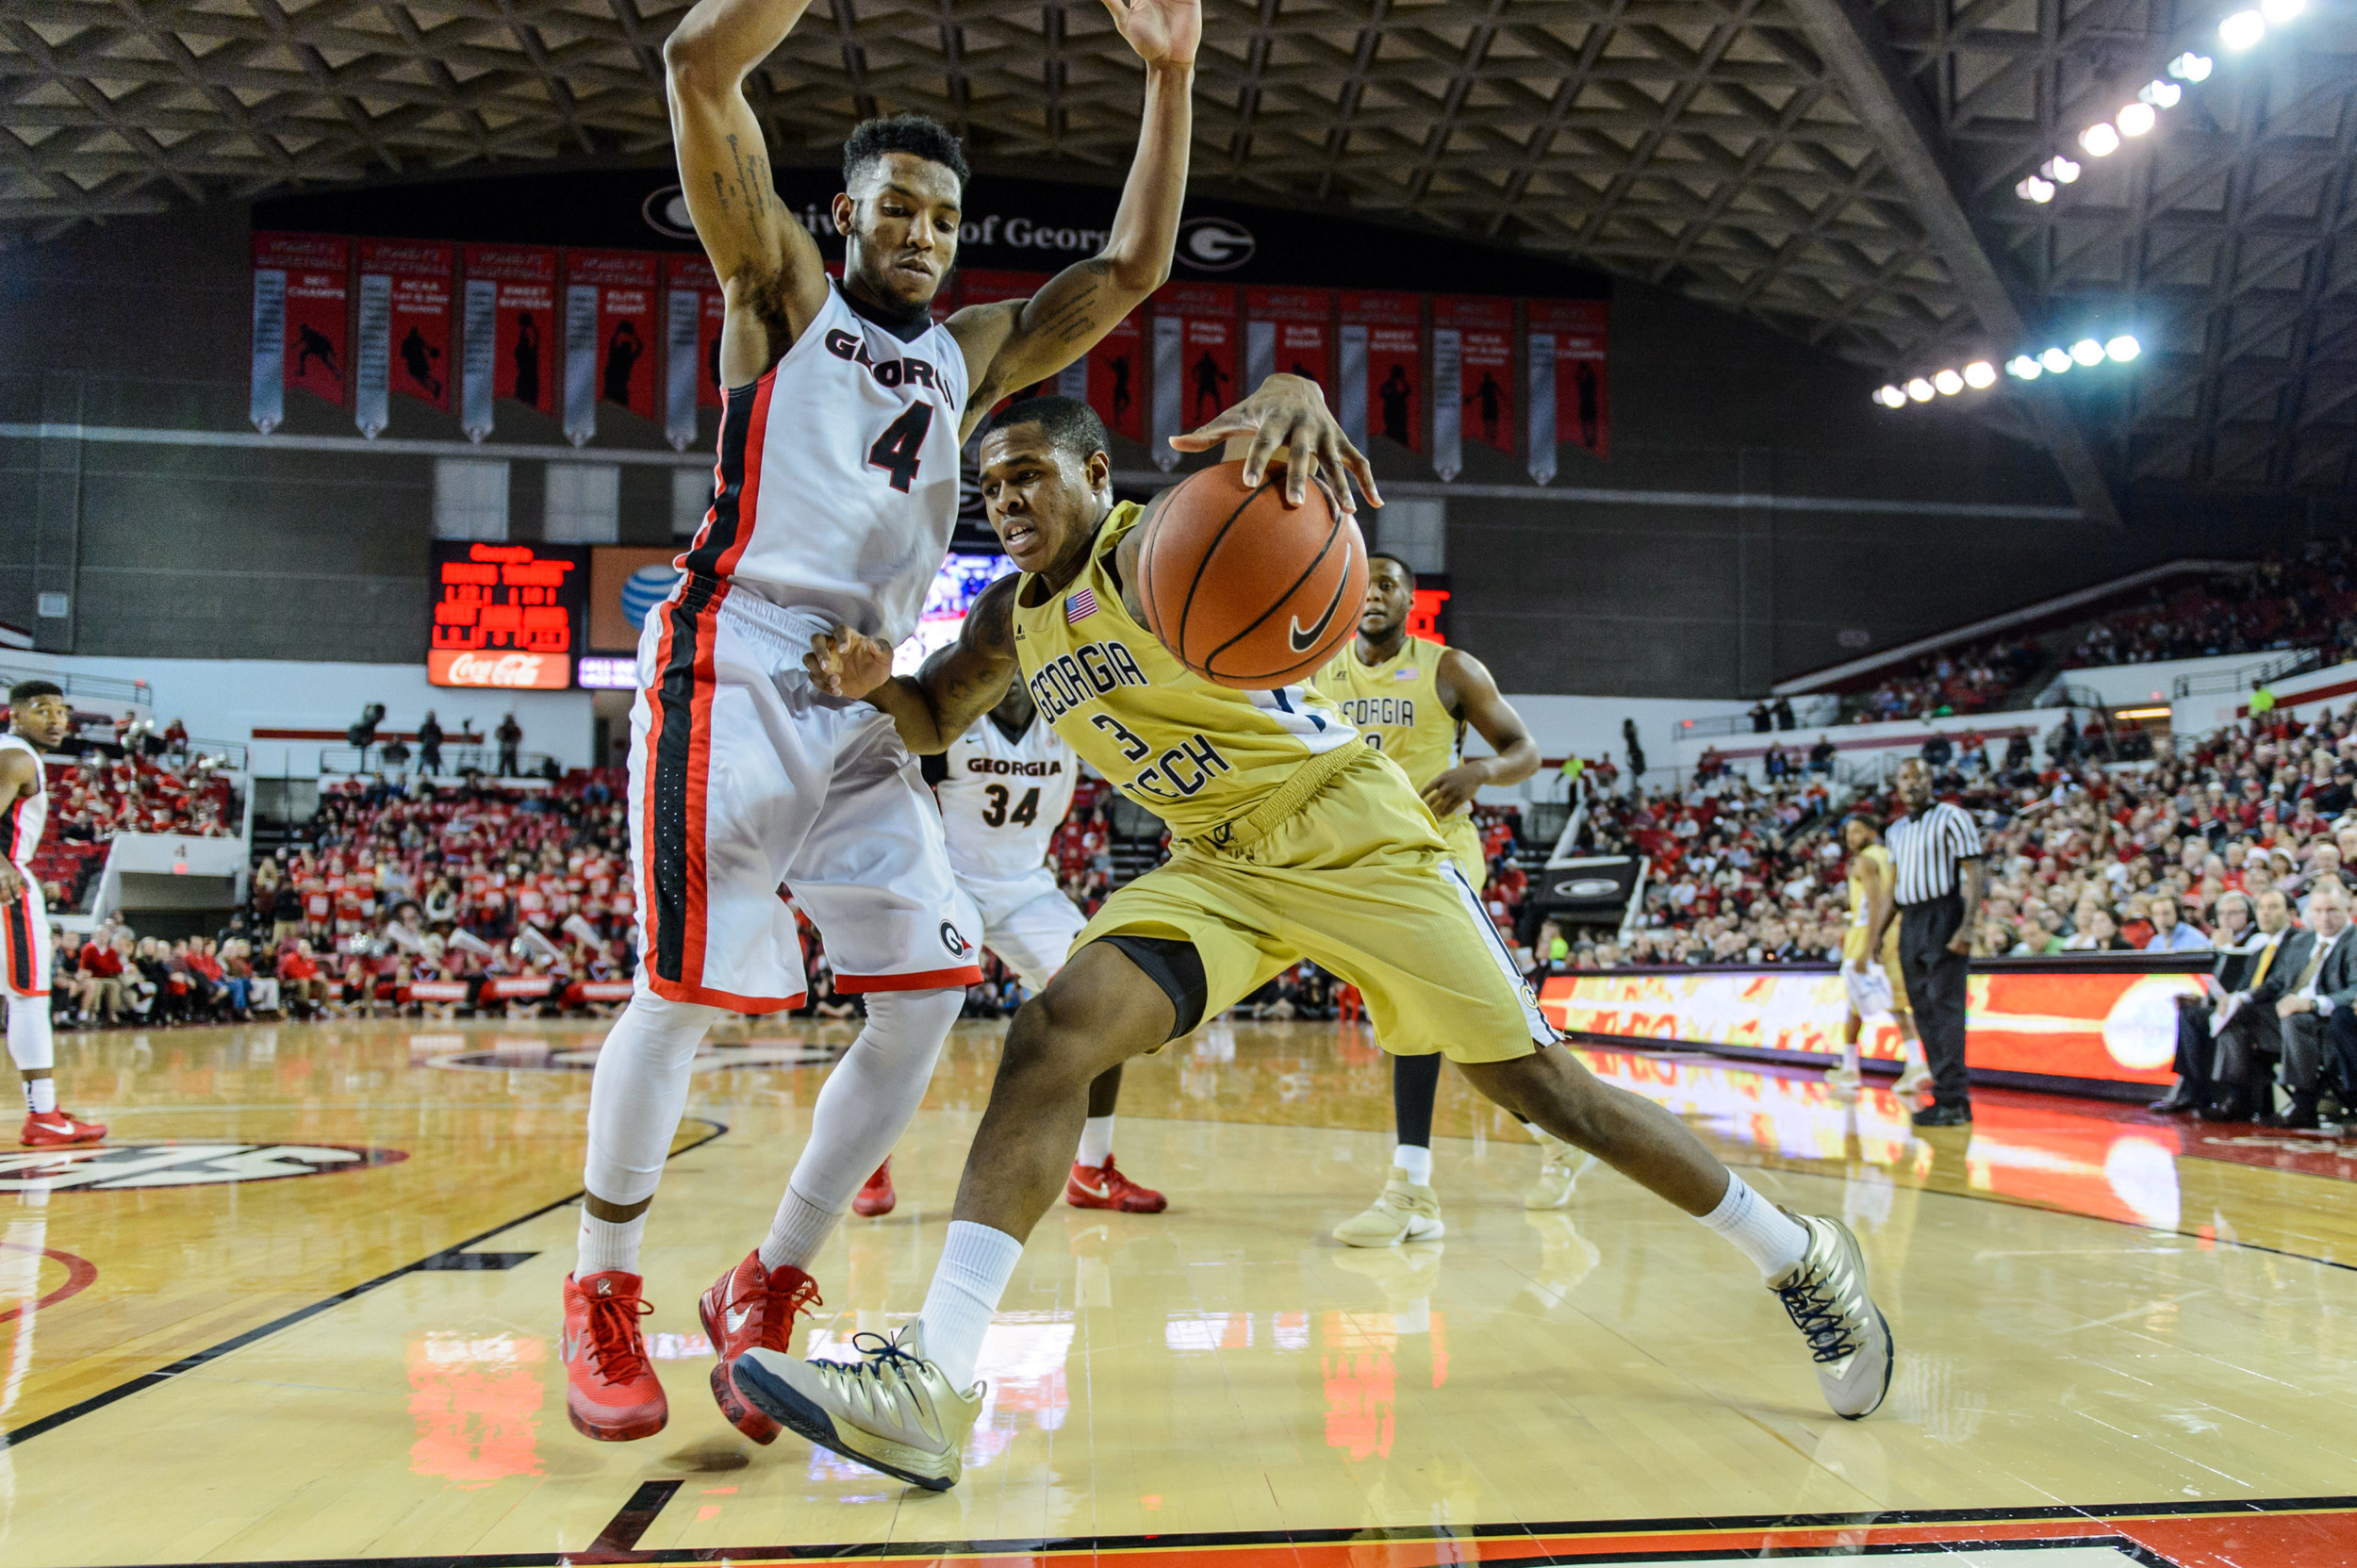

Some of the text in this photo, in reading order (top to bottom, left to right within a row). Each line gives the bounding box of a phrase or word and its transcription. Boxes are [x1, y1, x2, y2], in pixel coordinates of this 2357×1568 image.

[958, 214, 1000, 245] of
[868, 399, 934, 494] 4
[1030, 641, 1150, 724] GEORGIA
[1338, 697, 1414, 728] EORGIA
[1089, 713, 1152, 763] 3
[967, 758, 1063, 777] GEORGIA
[981, 784, 1041, 828] 34
